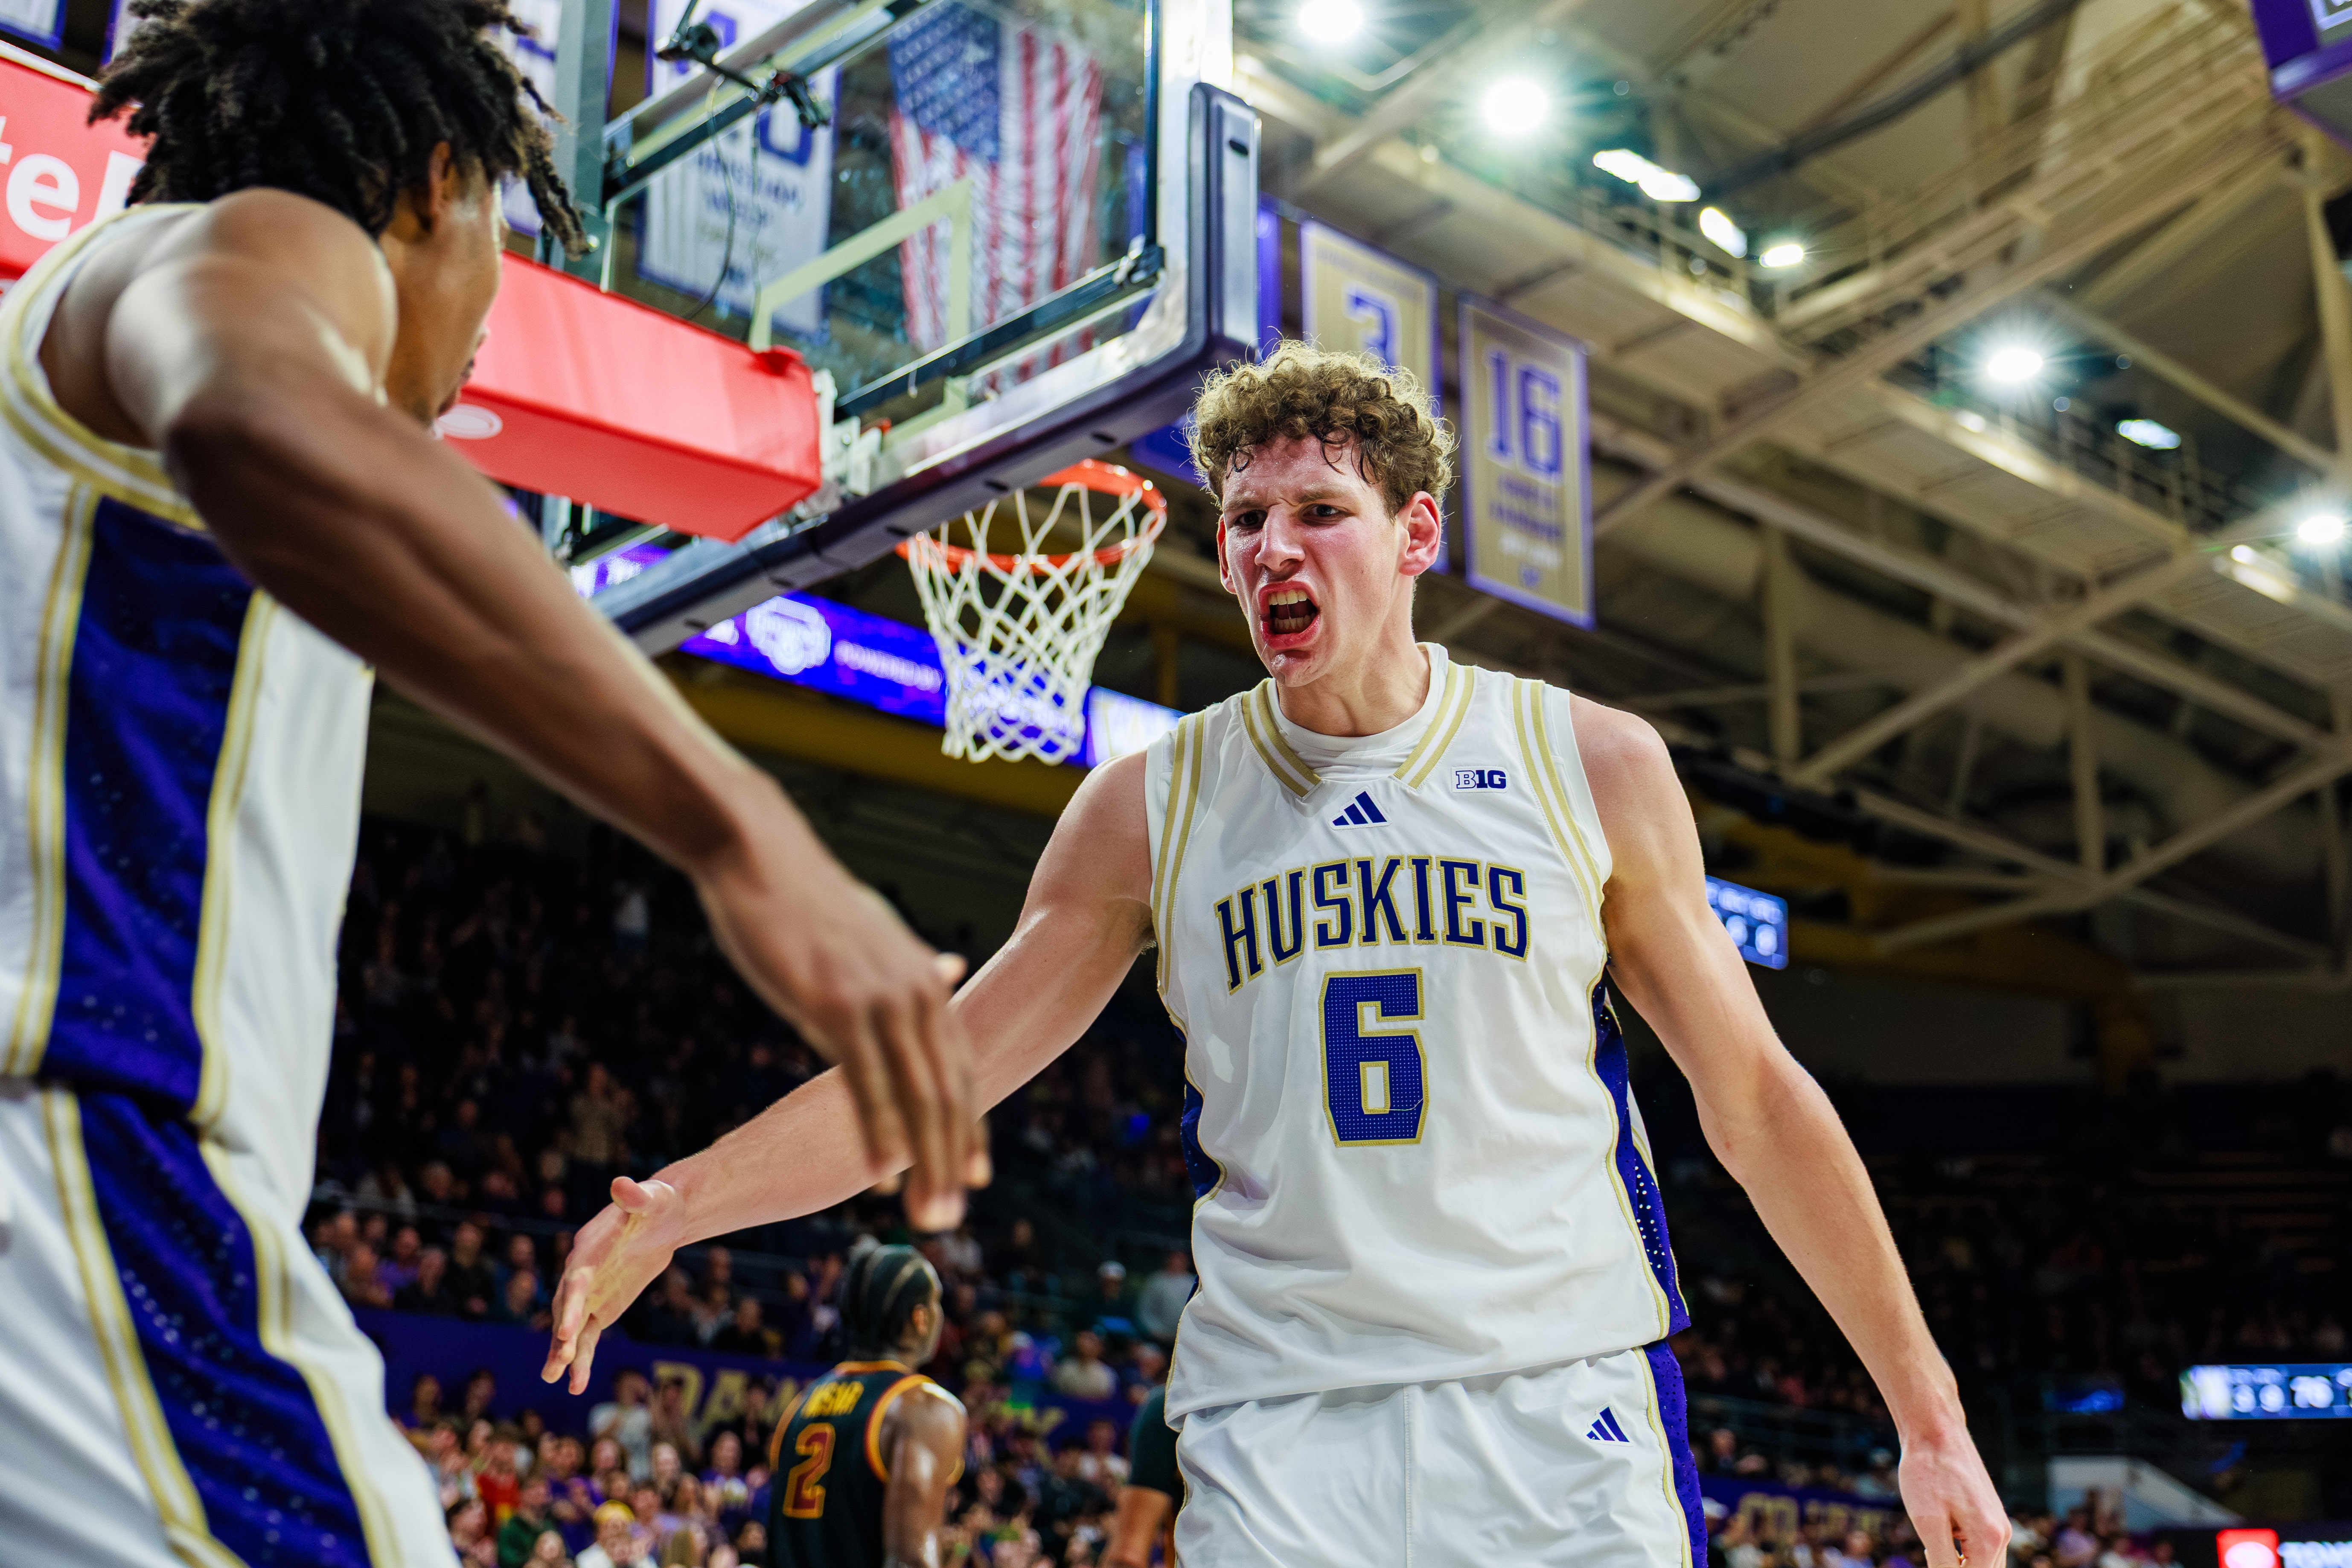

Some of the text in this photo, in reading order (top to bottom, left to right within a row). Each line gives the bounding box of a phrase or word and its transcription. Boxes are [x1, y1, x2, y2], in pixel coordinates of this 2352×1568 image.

[1487, 347, 1563, 483] 16
[1214, 855, 1531, 996] HUSKIES
[1318, 966, 1429, 1147] 6
[782, 1422, 836, 1519] 2
